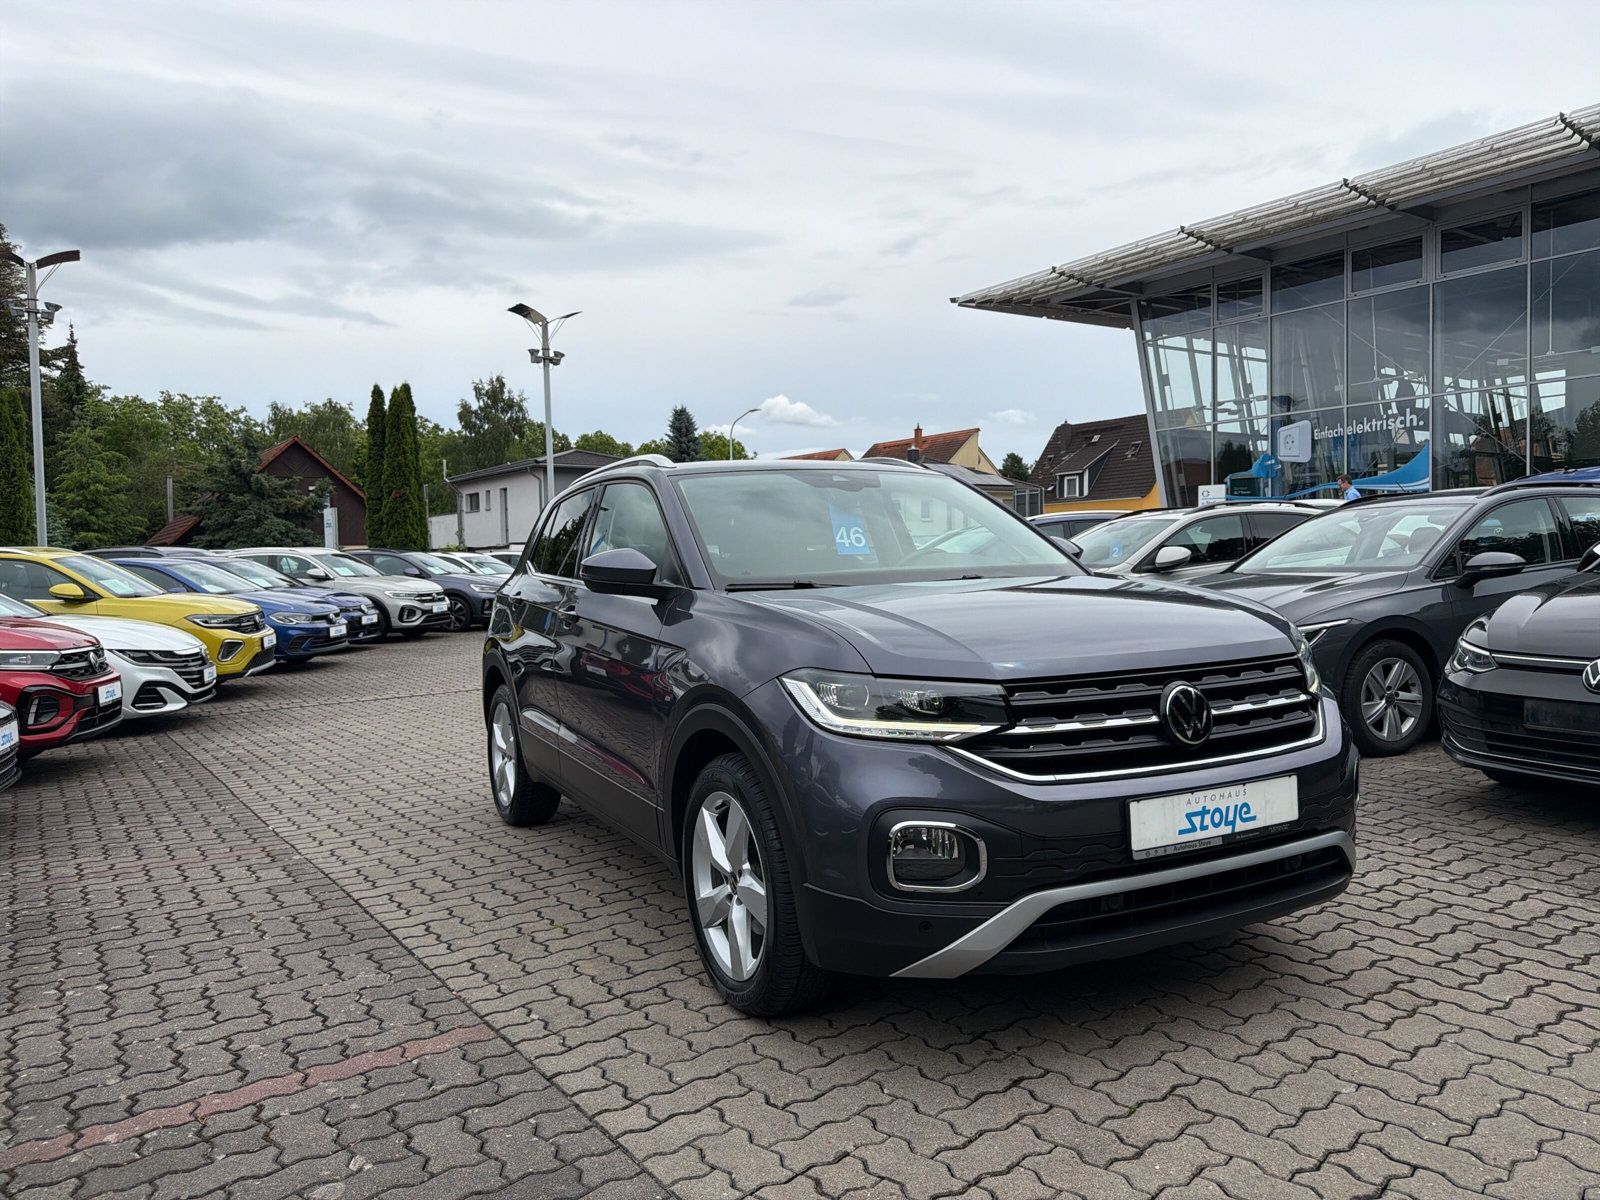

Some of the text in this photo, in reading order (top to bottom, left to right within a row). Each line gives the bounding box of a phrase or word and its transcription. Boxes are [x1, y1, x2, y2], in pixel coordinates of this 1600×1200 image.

[1314, 407, 1425, 440] Einfach elektrisch.
[835, 526, 866, 548] 46
[1111, 546, 1119, 558] 2
[1186, 788, 1248, 806] AUTOHAUS
[1173, 841, 1198, 852] Autohaus
